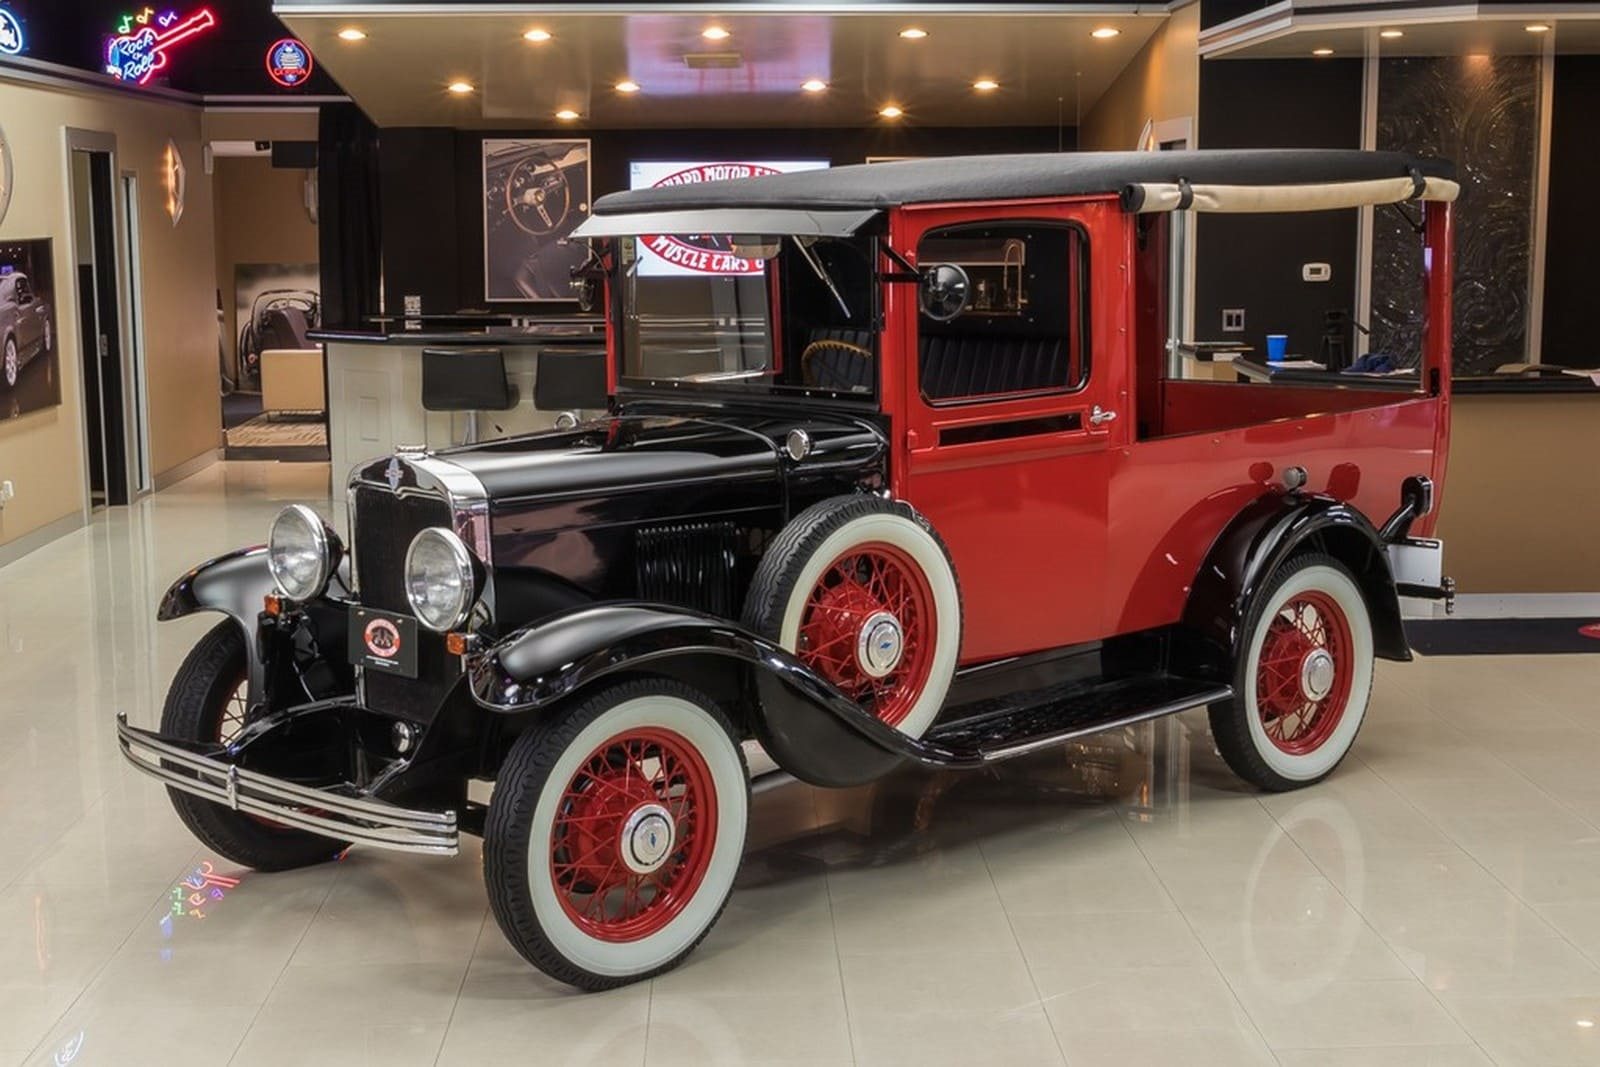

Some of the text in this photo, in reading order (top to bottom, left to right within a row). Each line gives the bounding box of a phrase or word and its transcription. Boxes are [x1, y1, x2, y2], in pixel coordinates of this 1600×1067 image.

[119, 30, 154, 56] Rock
[123, 52, 155, 80] Roll
[703, 165, 750, 182] MOTOR
[650, 235, 709, 269] MUSCLE
[711, 254, 749, 271] CARS
